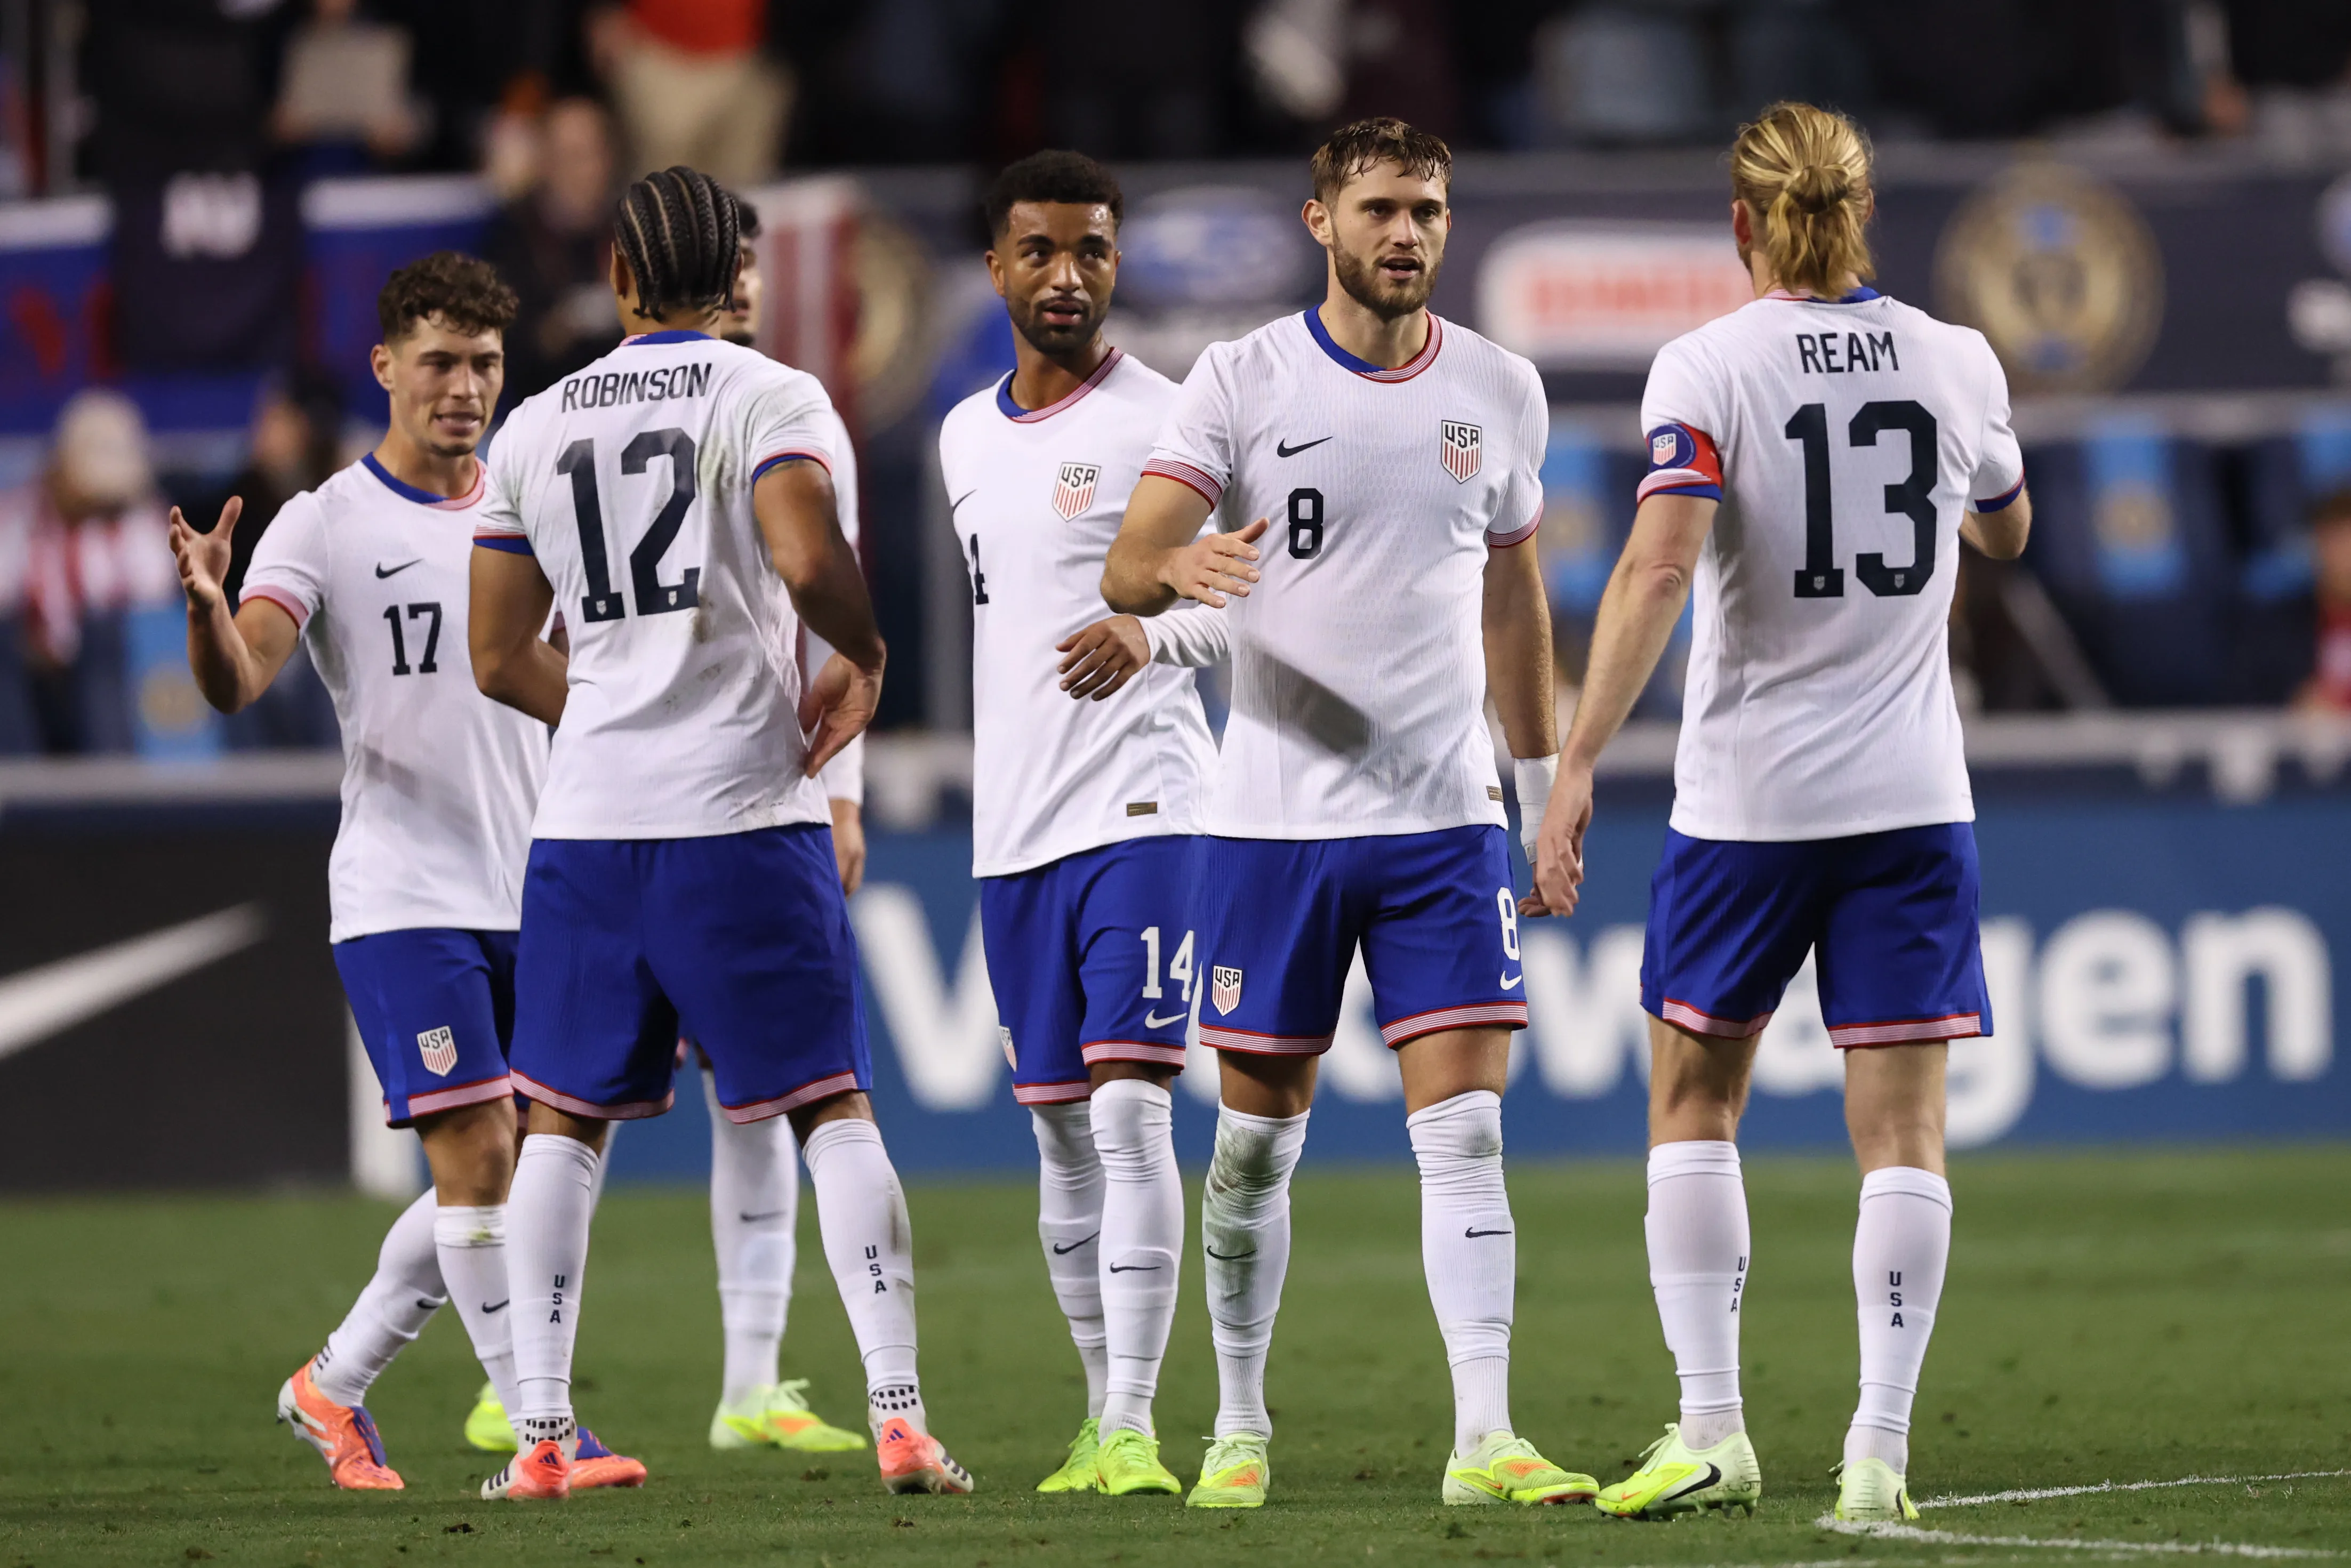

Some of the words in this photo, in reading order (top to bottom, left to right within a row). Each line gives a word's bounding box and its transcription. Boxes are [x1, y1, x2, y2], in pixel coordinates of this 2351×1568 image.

[1796, 332, 1899, 373] REAM
[561, 363, 712, 413] ROBINSON
[1445, 424, 1479, 448] USA
[1654, 436, 1674, 448] USA
[1061, 466, 1096, 488] USA
[1785, 400, 1937, 598] 13
[557, 428, 701, 623] 12
[1288, 488, 1323, 560] 8
[383, 601, 442, 676] 17
[1497, 887, 1520, 961] 8
[1140, 926, 1194, 1002] 14
[1215, 968, 1240, 988] USA
[420, 1030, 450, 1050] USA
[854, 881, 2336, 1149] Vwagen
[864, 1244, 887, 1294] USA
[1730, 1256, 1747, 1313] USA
[549, 1274, 565, 1324] USA
[1889, 1271, 1904, 1328] USA
